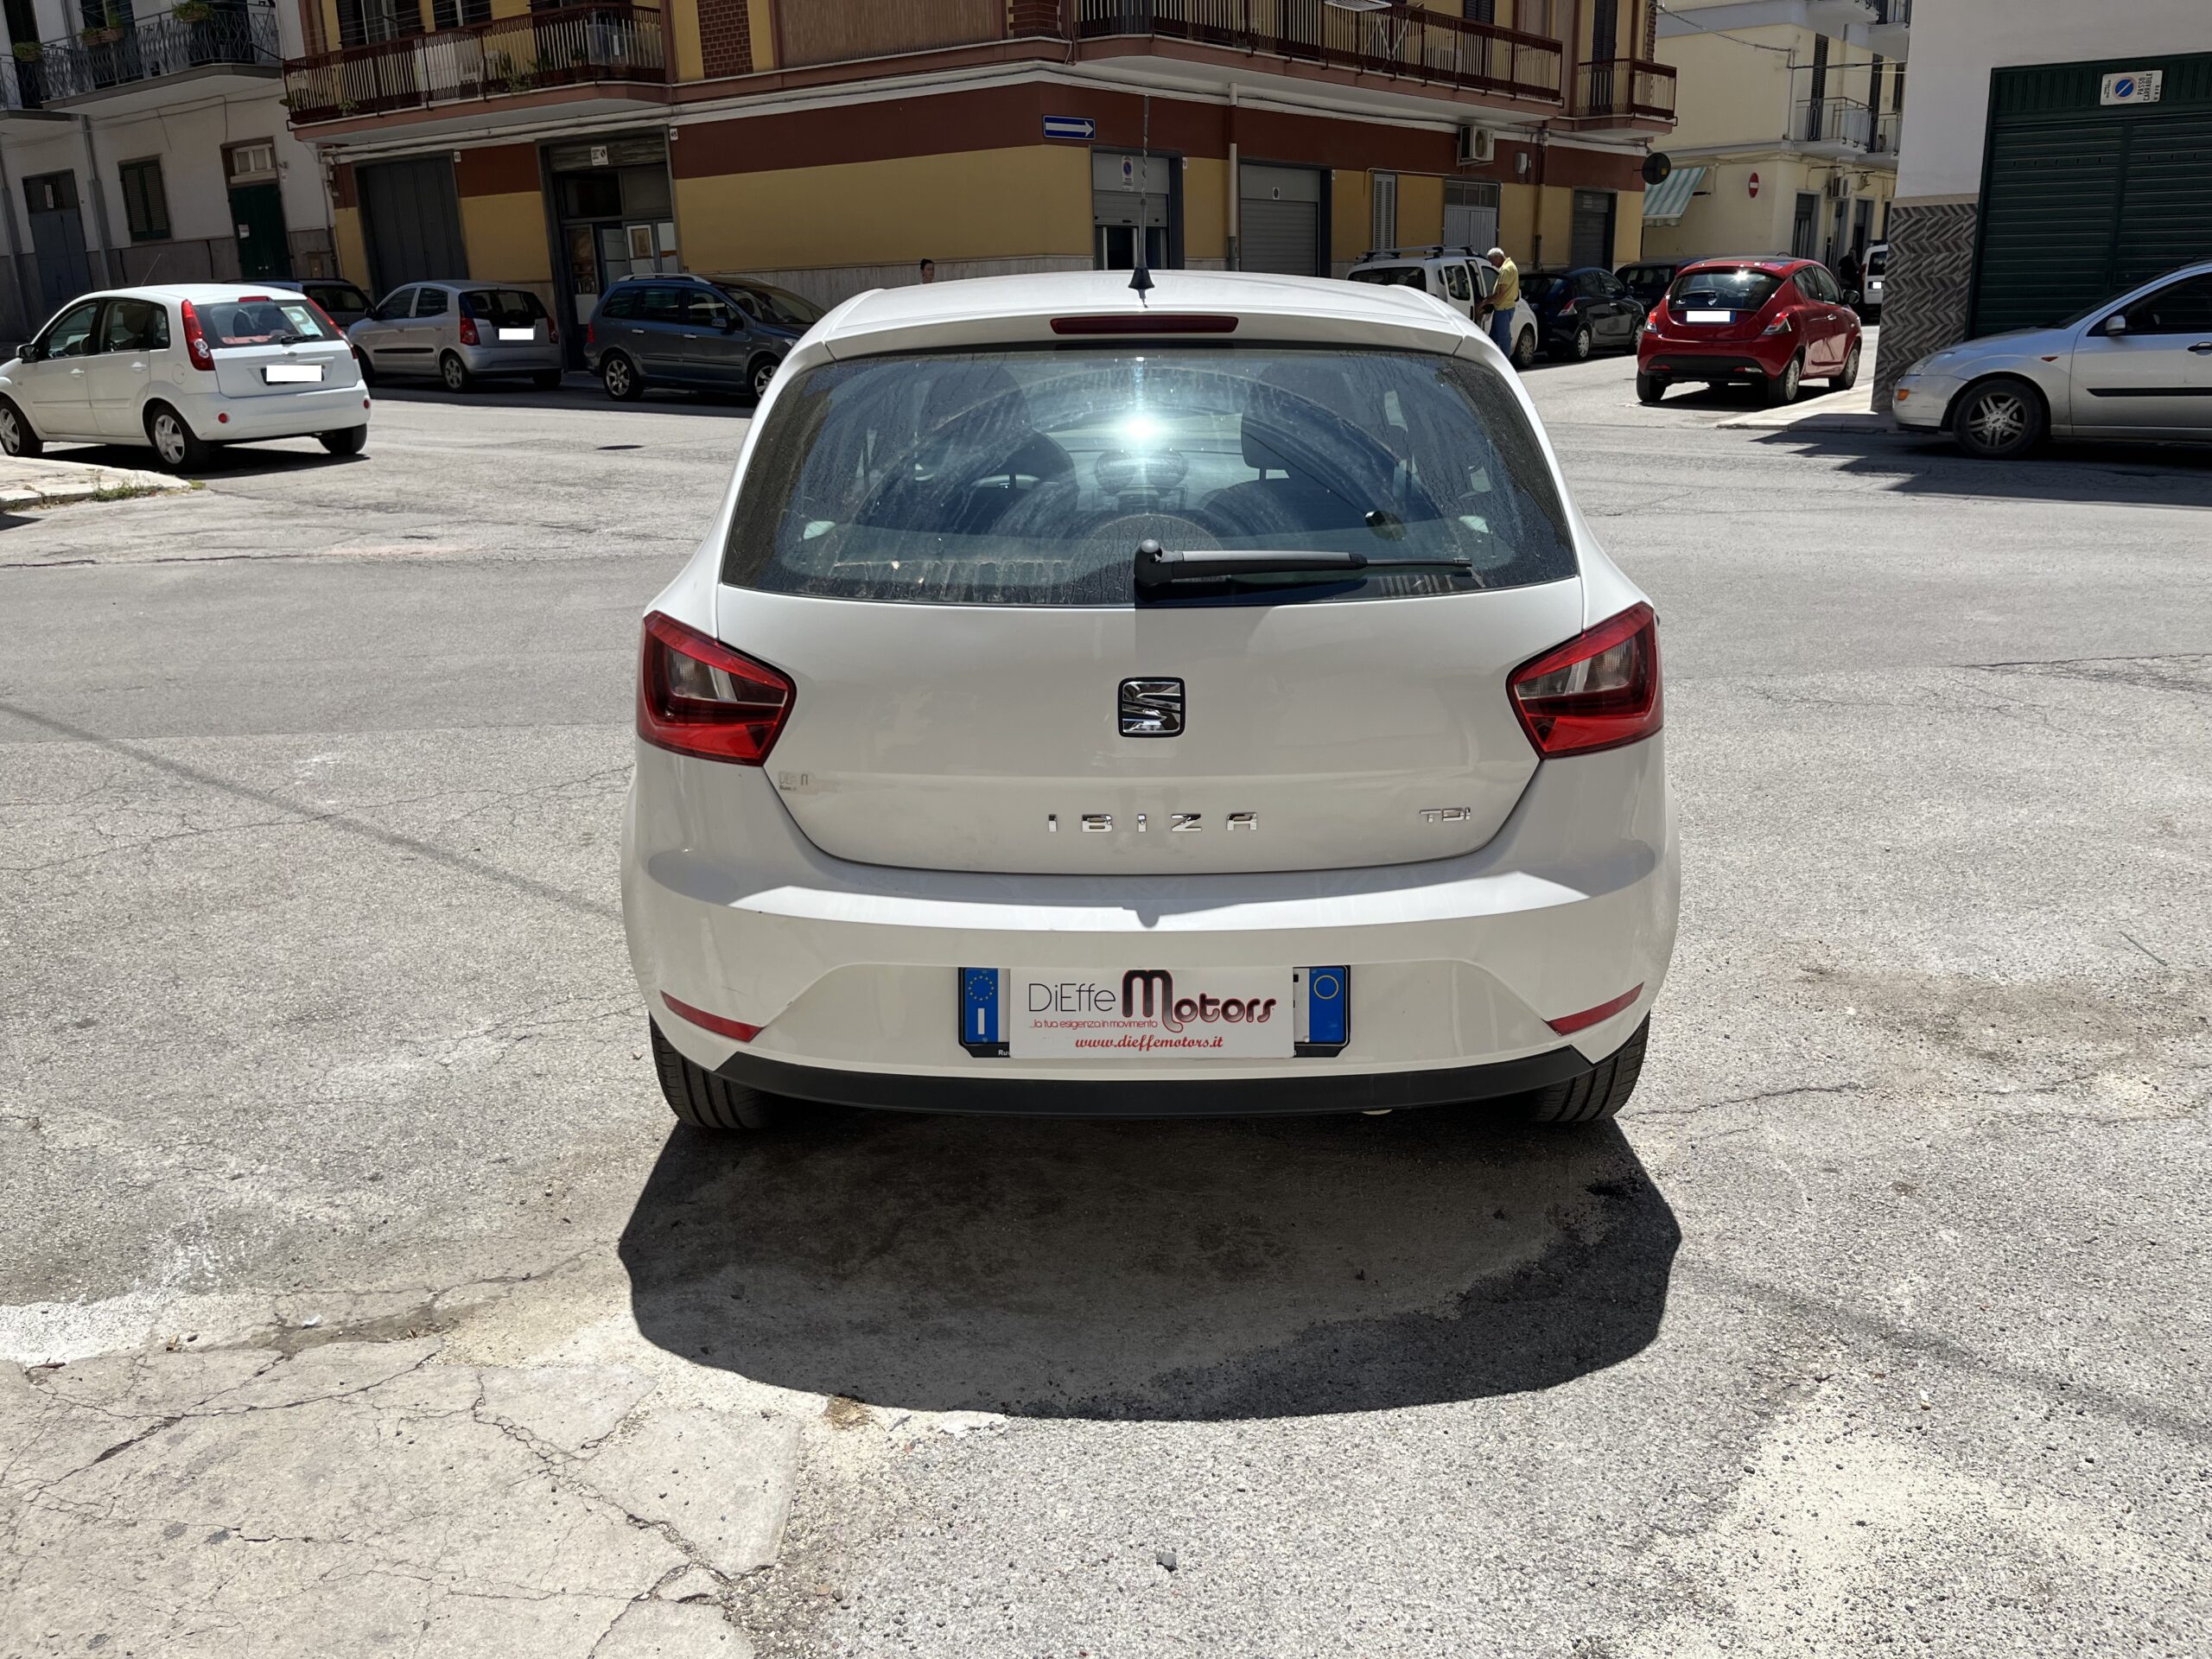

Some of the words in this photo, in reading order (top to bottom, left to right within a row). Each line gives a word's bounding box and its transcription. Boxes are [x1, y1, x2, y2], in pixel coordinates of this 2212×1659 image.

[2137, 77, 2145, 95] PASSO
[2143, 73, 2153, 101] CARRABILE
[1048, 812, 1257, 833] IBIZA
[1419, 807, 1471, 823] TDI
[1028, 982, 1116, 1012] DiEffe
[1122, 969, 1277, 1033] Motors
[977, 1007, 985, 1035] I
[1044, 1020, 1058, 1028] tua
[1059, 1020, 1101, 1030] esigenza
[1102, 1020, 1109, 1028] in
[1109, 1020, 1159, 1028] movimento
[1075, 1034, 1224, 1052] www.dieffemotors.it
